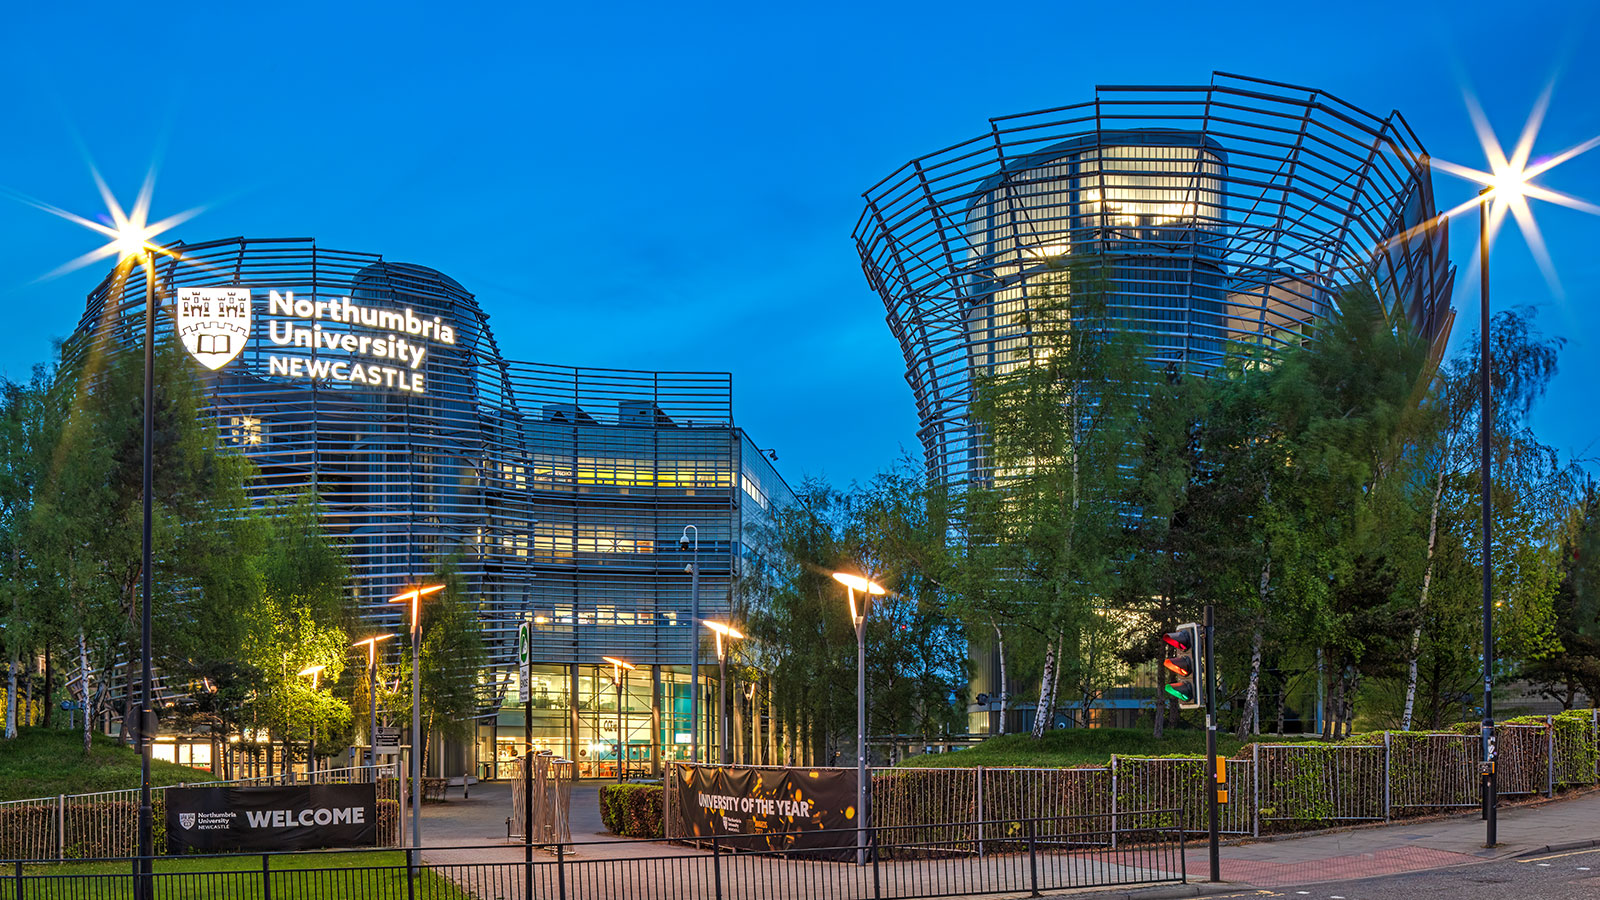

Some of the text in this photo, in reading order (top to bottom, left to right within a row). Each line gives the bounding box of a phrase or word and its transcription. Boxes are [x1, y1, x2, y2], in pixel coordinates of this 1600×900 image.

[268, 289, 455, 345] Northumbria
[268, 319, 426, 369] University
[268, 355, 425, 393] NEWCASTLE
[246, 807, 365, 829] WELCOME
[698, 793, 810, 818] UNIVERSITY OF THE YEAR
